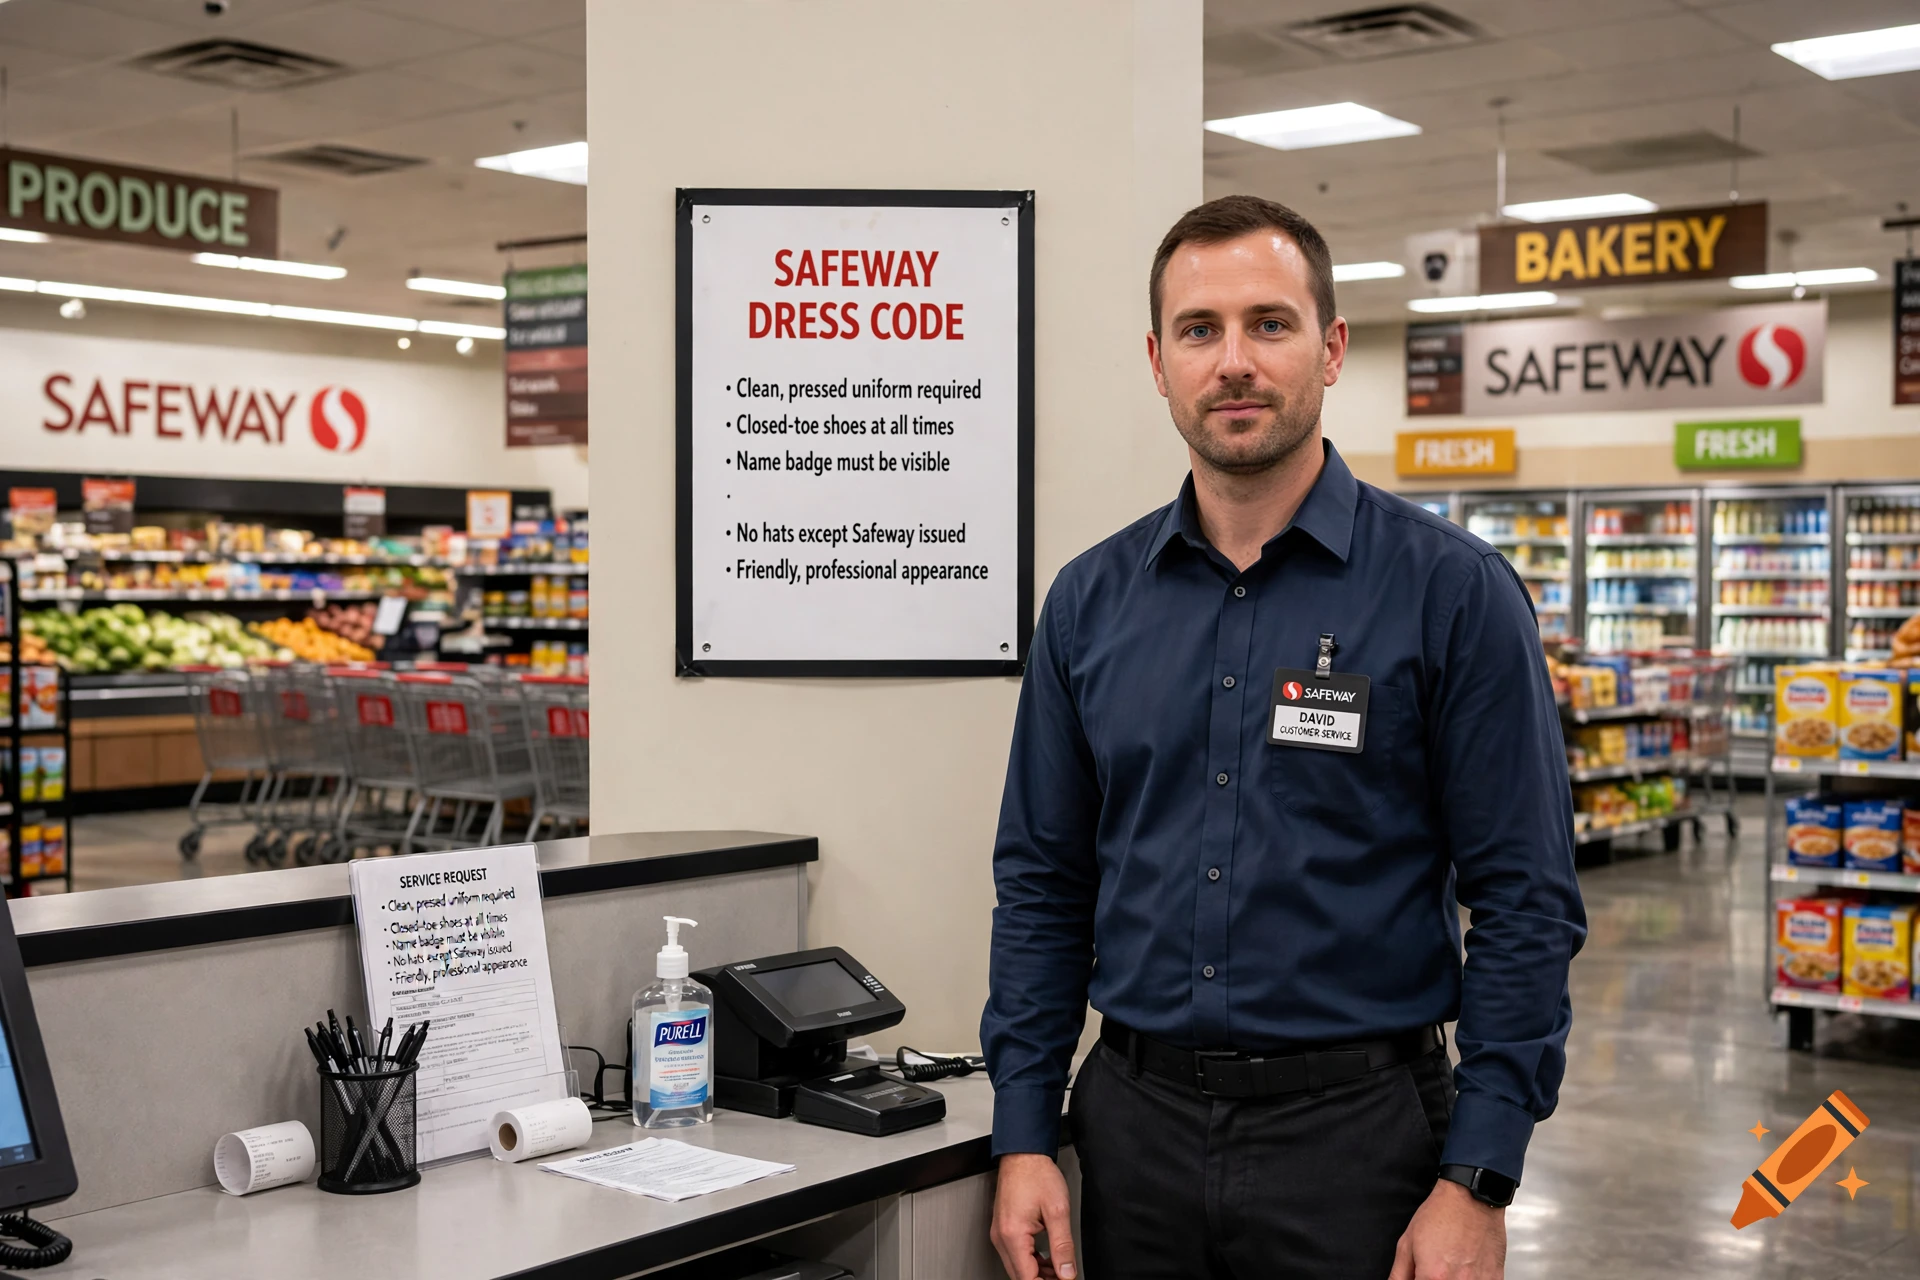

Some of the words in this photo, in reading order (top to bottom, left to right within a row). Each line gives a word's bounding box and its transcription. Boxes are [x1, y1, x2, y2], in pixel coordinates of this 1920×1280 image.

[8, 159, 248, 246] PRODUCE
[1516, 214, 1727, 284] BAKERY
[775, 249, 939, 287] SAFEWAY
[750, 302, 859, 339] DRESS
[871, 302, 963, 340] CODE
[1486, 335, 1726, 396] SAFEWAY
[737, 377, 783, 401] Clean,
[789, 378, 847, 403] pressed
[853, 378, 912, 398] uniform
[918, 379, 981, 404] required
[42, 373, 296, 444] SAFEWAY
[737, 414, 819, 434] Closed-toe
[824, 414, 866, 434] shoes
[871, 417, 886, 434] at
[891, 415, 907, 434] all
[913, 416, 954, 435] times
[1695, 427, 1776, 460] FRESH
[737, 451, 780, 470] Name
[786, 450, 832, 476] badge
[838, 454, 874, 471] must
[879, 451, 897, 471] be
[901, 451, 950, 471] visible
[738, 523, 758, 542] No
[763, 522, 794, 542] hats
[799, 525, 848, 548] except
[853, 522, 915, 548] Safeway
[920, 523, 965, 543] issued
[737, 558, 800, 585] Friendly,
[806, 559, 896, 585] professional
[902, 565, 988, 585] appearance
[1304, 688, 1356, 702] SAFEWAY
[1300, 712, 1335, 726] DAVID
[1280, 726, 1319, 737] CUSTOMER
[1322, 730, 1351, 740] SERVICE
[400, 873, 441, 888] SERVICE
[444, 868, 487, 884] REQUEST
[659, 1022, 702, 1042] PURELL
